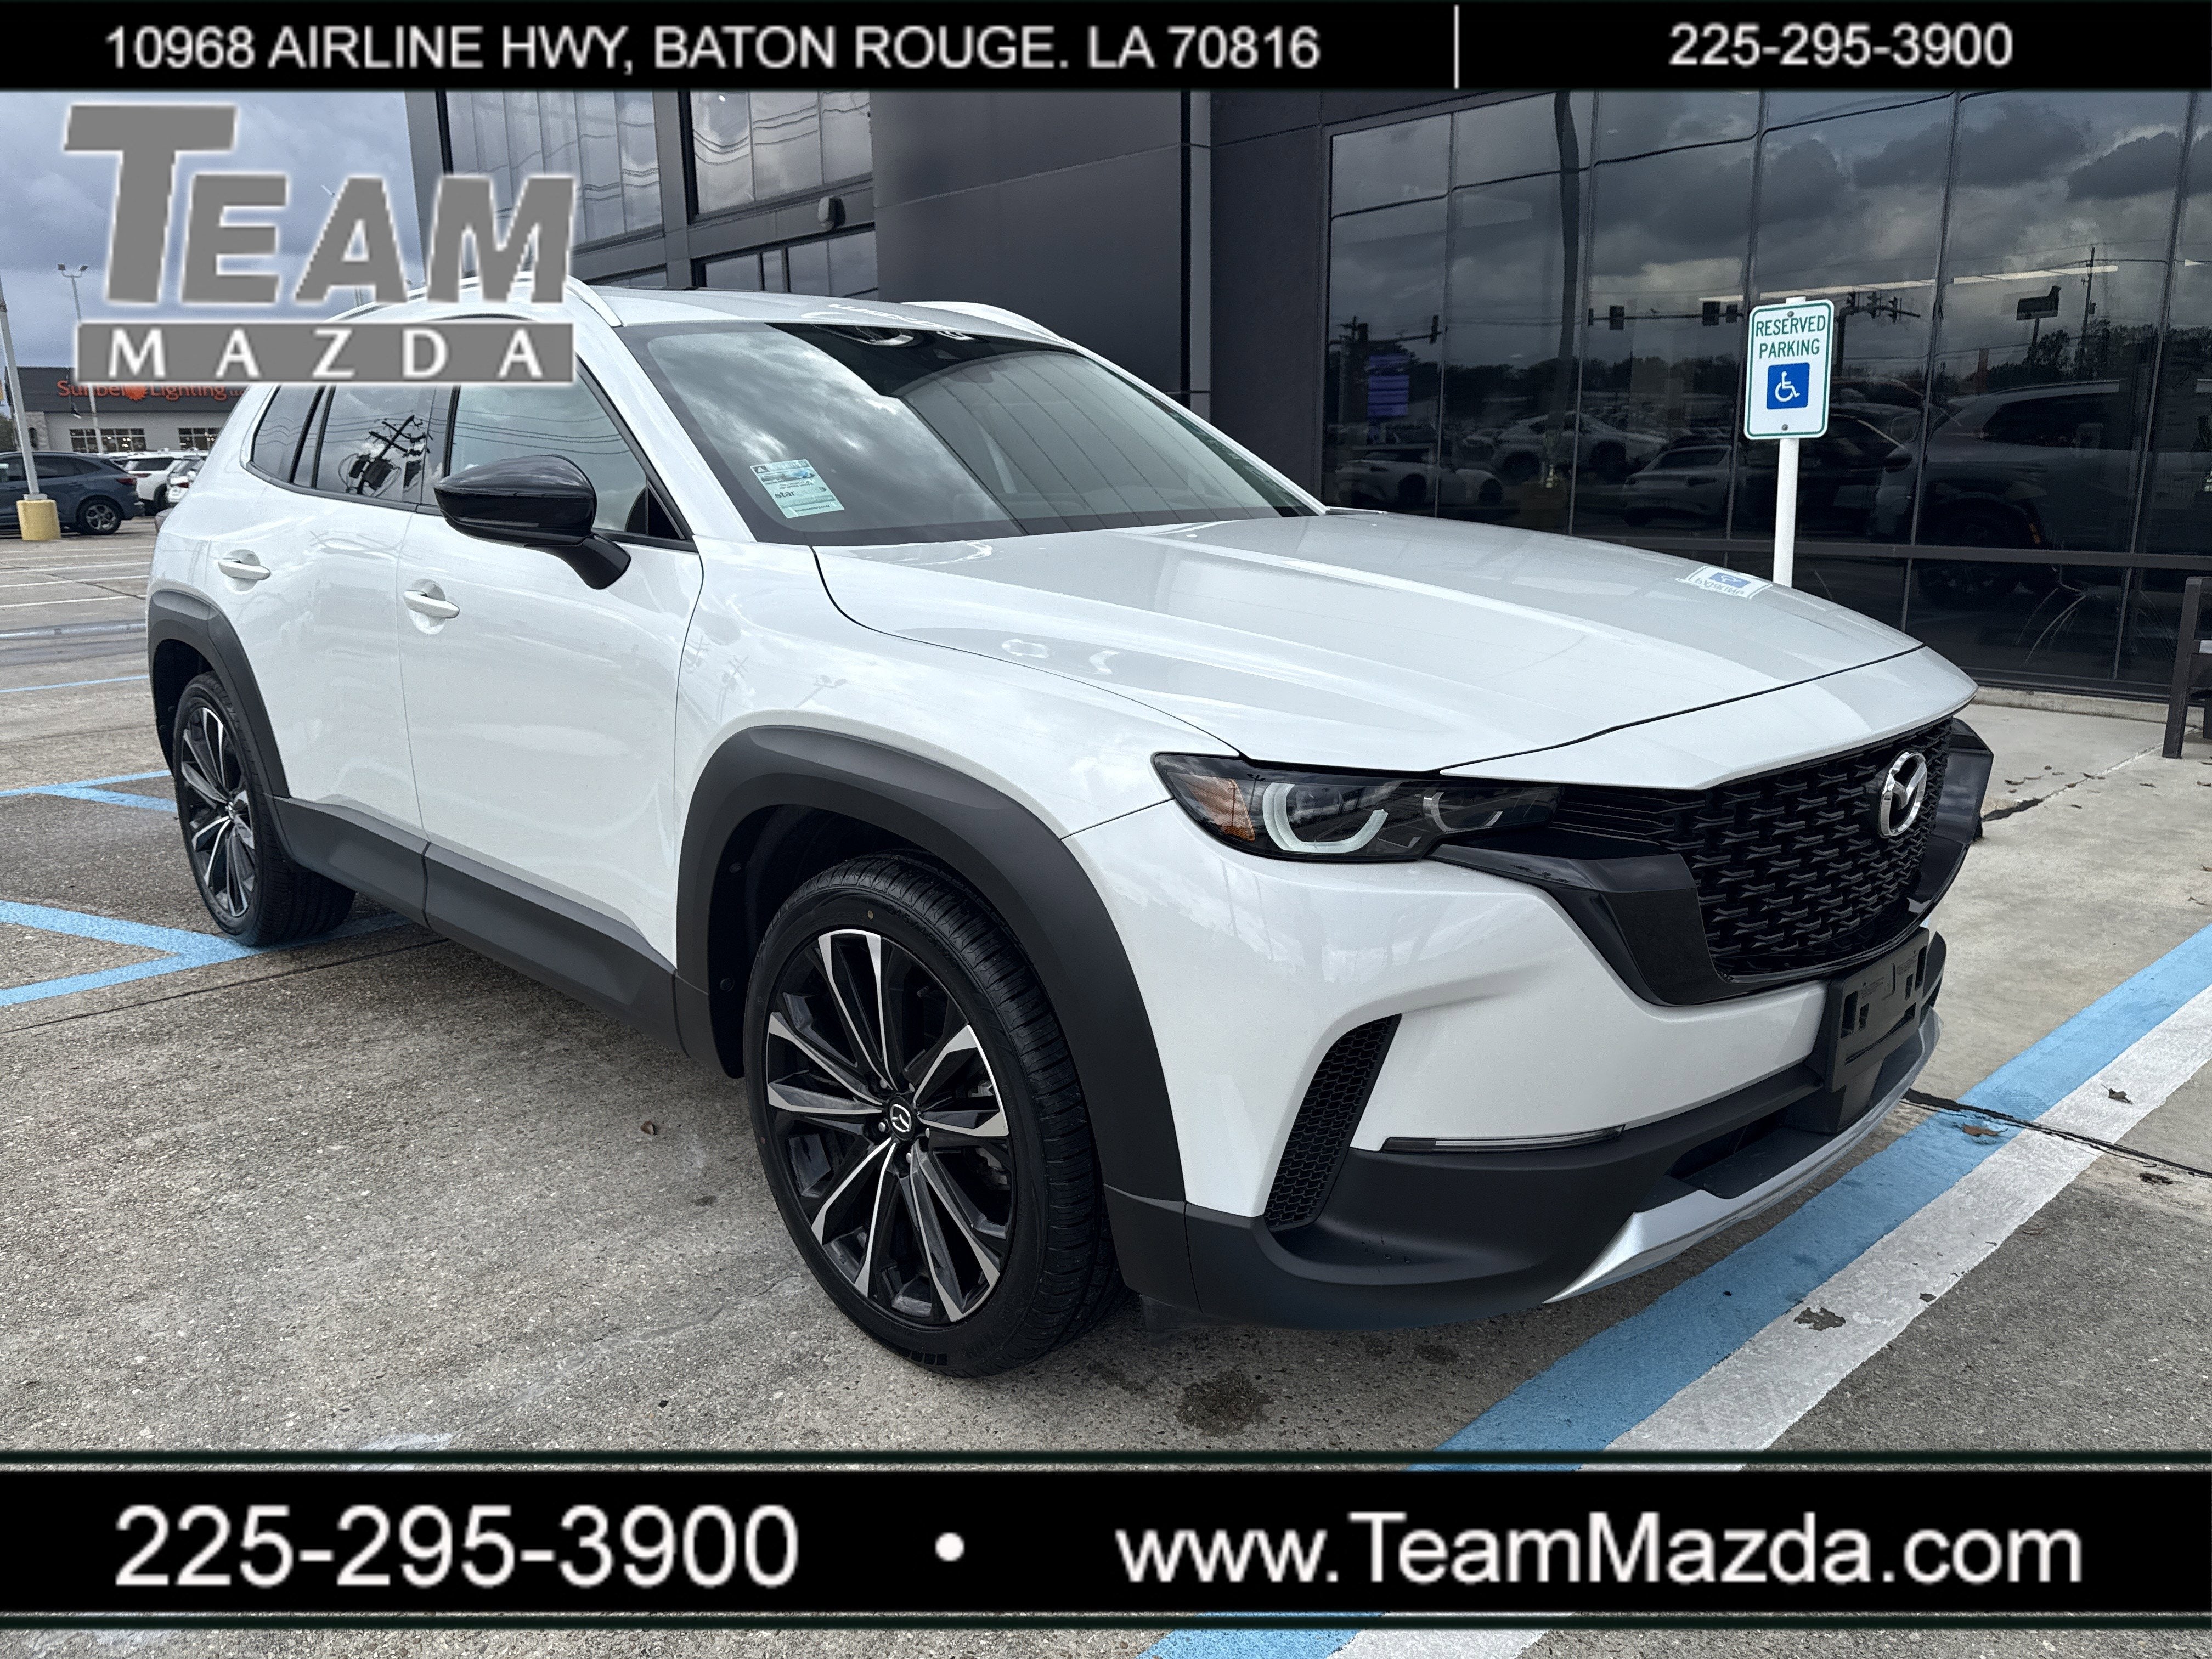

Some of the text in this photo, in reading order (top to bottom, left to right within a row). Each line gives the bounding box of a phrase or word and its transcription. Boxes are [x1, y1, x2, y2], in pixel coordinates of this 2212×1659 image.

[1756, 315, 1826, 337] RESERVED
[1759, 338, 1820, 359] PARKING
[150, 383, 228, 401] Lighting
